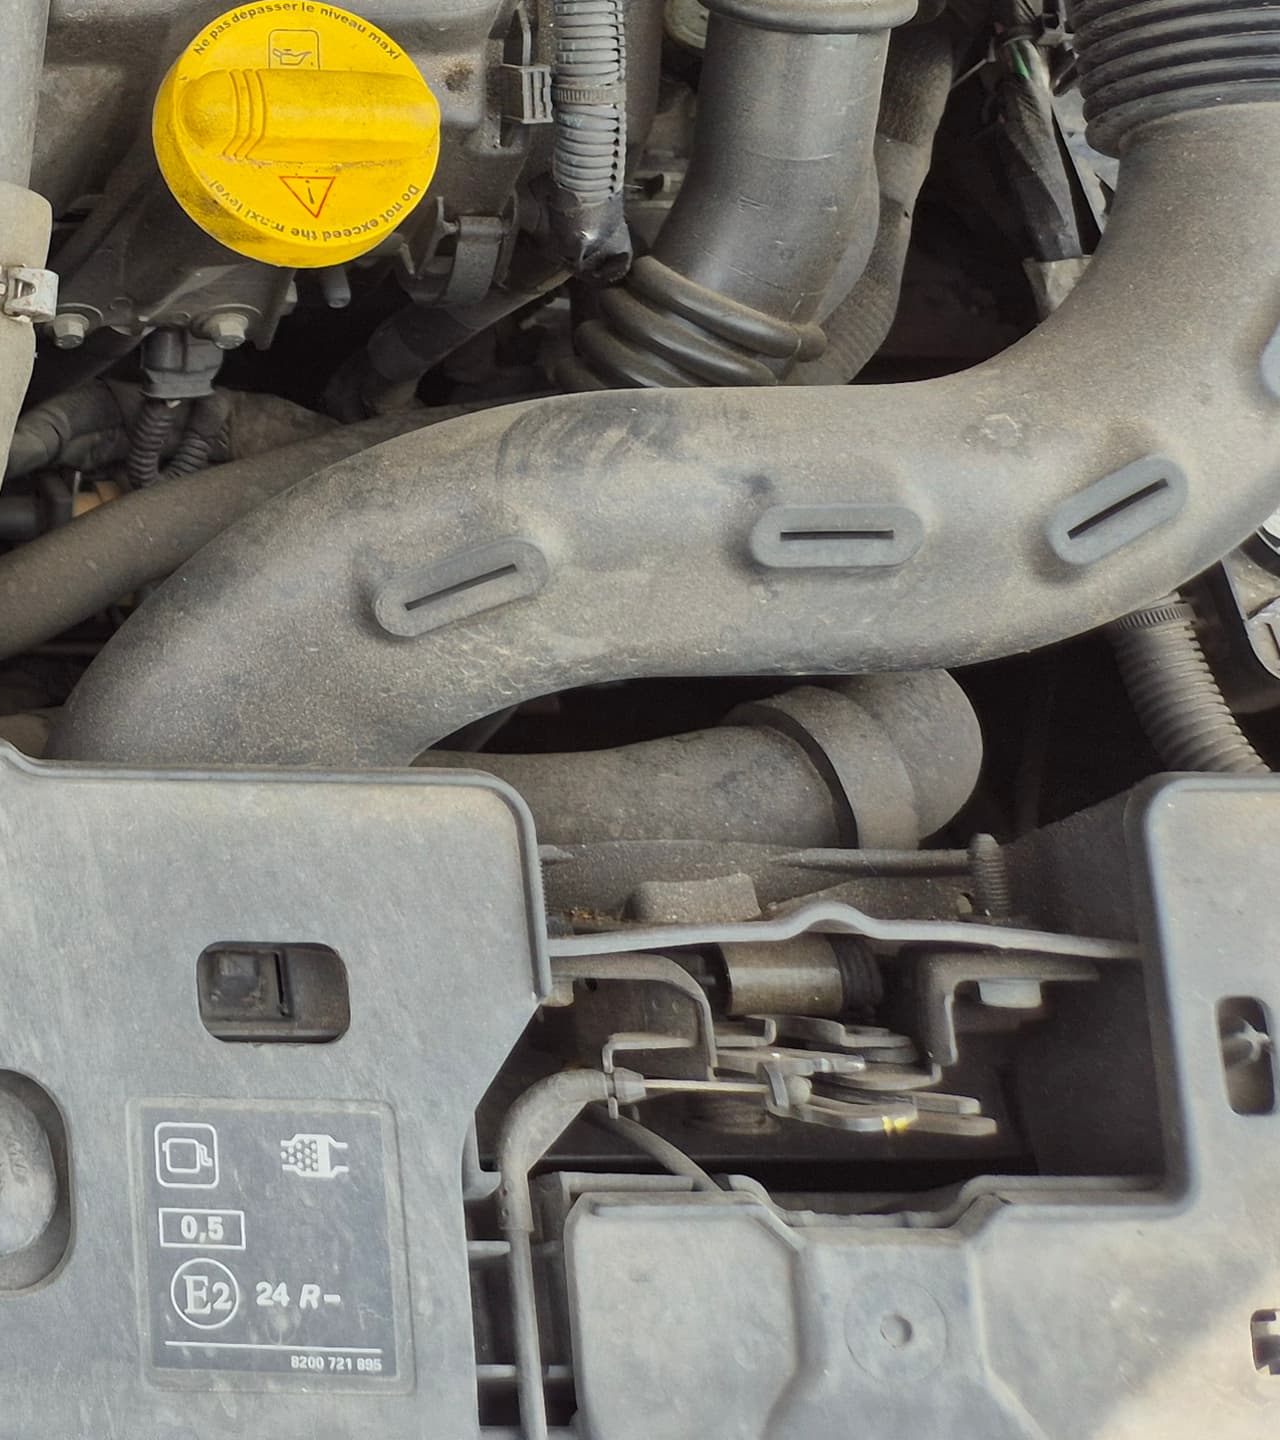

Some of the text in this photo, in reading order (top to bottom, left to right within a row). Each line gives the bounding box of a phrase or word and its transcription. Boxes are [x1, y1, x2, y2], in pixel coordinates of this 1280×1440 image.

[193, 37, 210, 56] Ne
[210, 20, 232, 41] pas
[301, 1, 315, 13] le
[320, 7, 367, 33] niveau
[368, 30, 402, 60] maxi
[402, 183, 420, 202] Do
[383, 201, 403, 220] not
[290, 225, 318, 241] the
[323, 217, 381, 242] exceed
[180, 1214, 224, 1243] 0,5
[182, 1275, 233, 1315] E2
[255, 1281, 290, 1307] 24
[328, 1357, 352, 1371] 721
